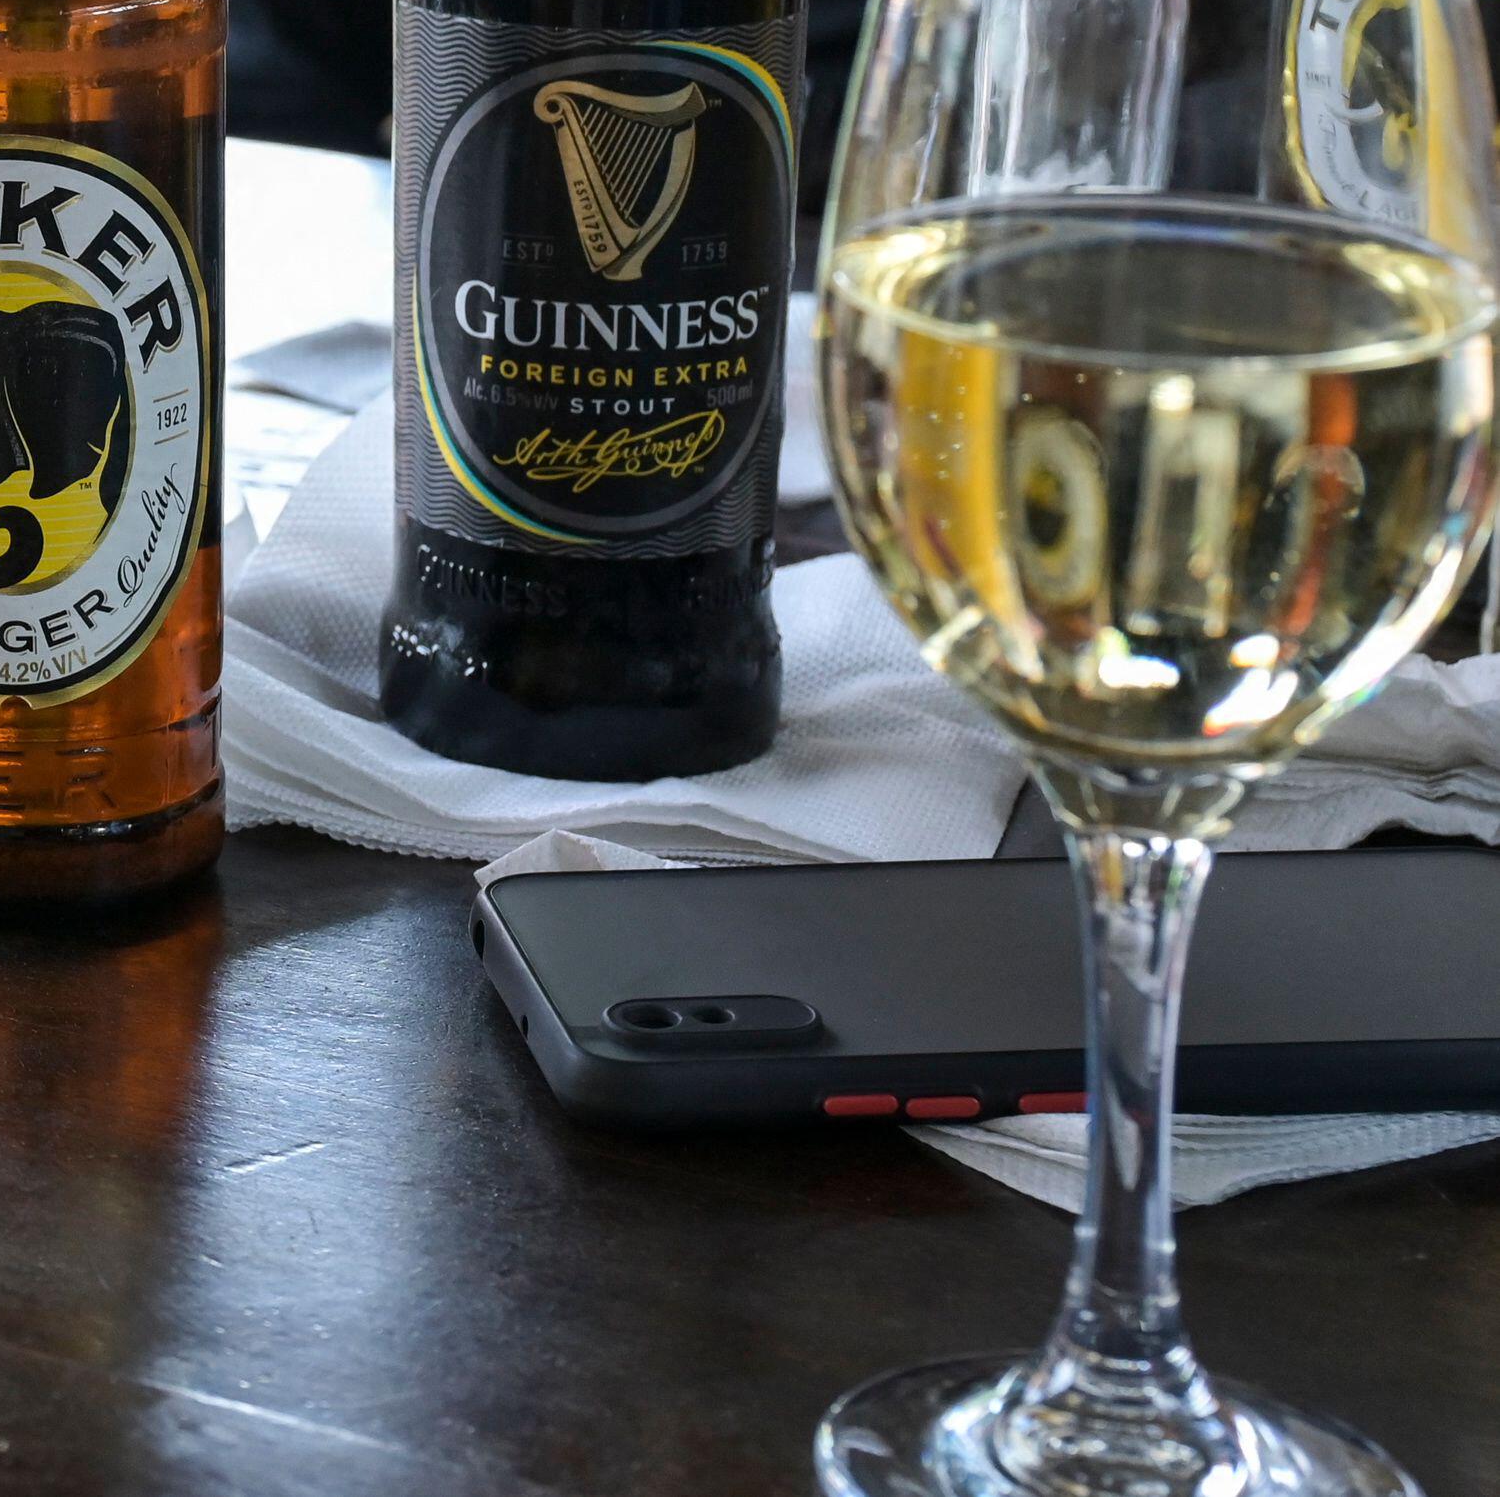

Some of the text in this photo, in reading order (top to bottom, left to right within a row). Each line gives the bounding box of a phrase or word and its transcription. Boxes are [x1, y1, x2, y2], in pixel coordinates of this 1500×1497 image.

[681, 240, 729, 264] 1759
[454, 279, 760, 352] GUINNESS
[480, 354, 748, 388] FOREIGN EXTRA
[156, 403, 188, 430] 1922
[569, 397, 677, 416] STOUT
[116, 461, 187, 608] Quality
[55, 645, 89, 677] V/V
